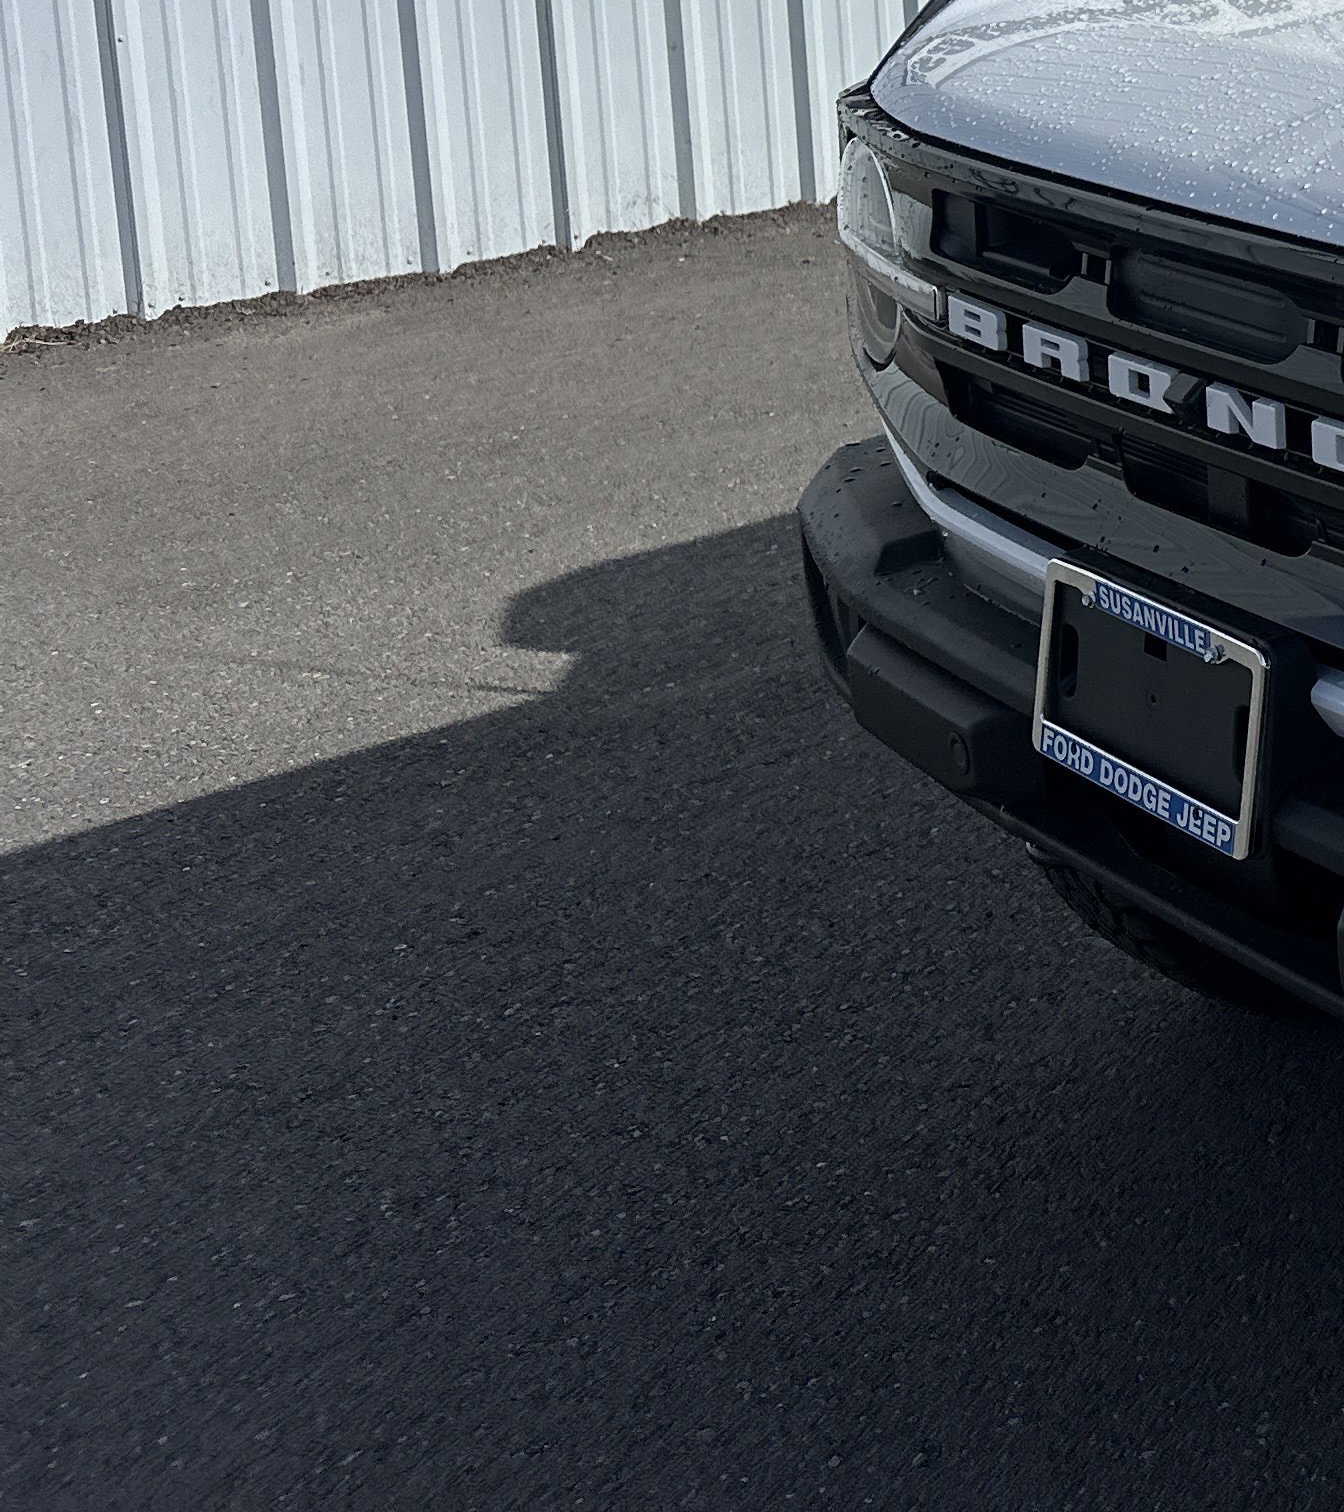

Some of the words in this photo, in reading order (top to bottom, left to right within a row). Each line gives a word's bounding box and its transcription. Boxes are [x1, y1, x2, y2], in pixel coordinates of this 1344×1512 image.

[1098, 585, 1207, 655] SUSANVILLE
[1041, 727, 1094, 776] FORD
[1099, 761, 1171, 818] DODGE
[1176, 803, 1232, 849] JEEP
